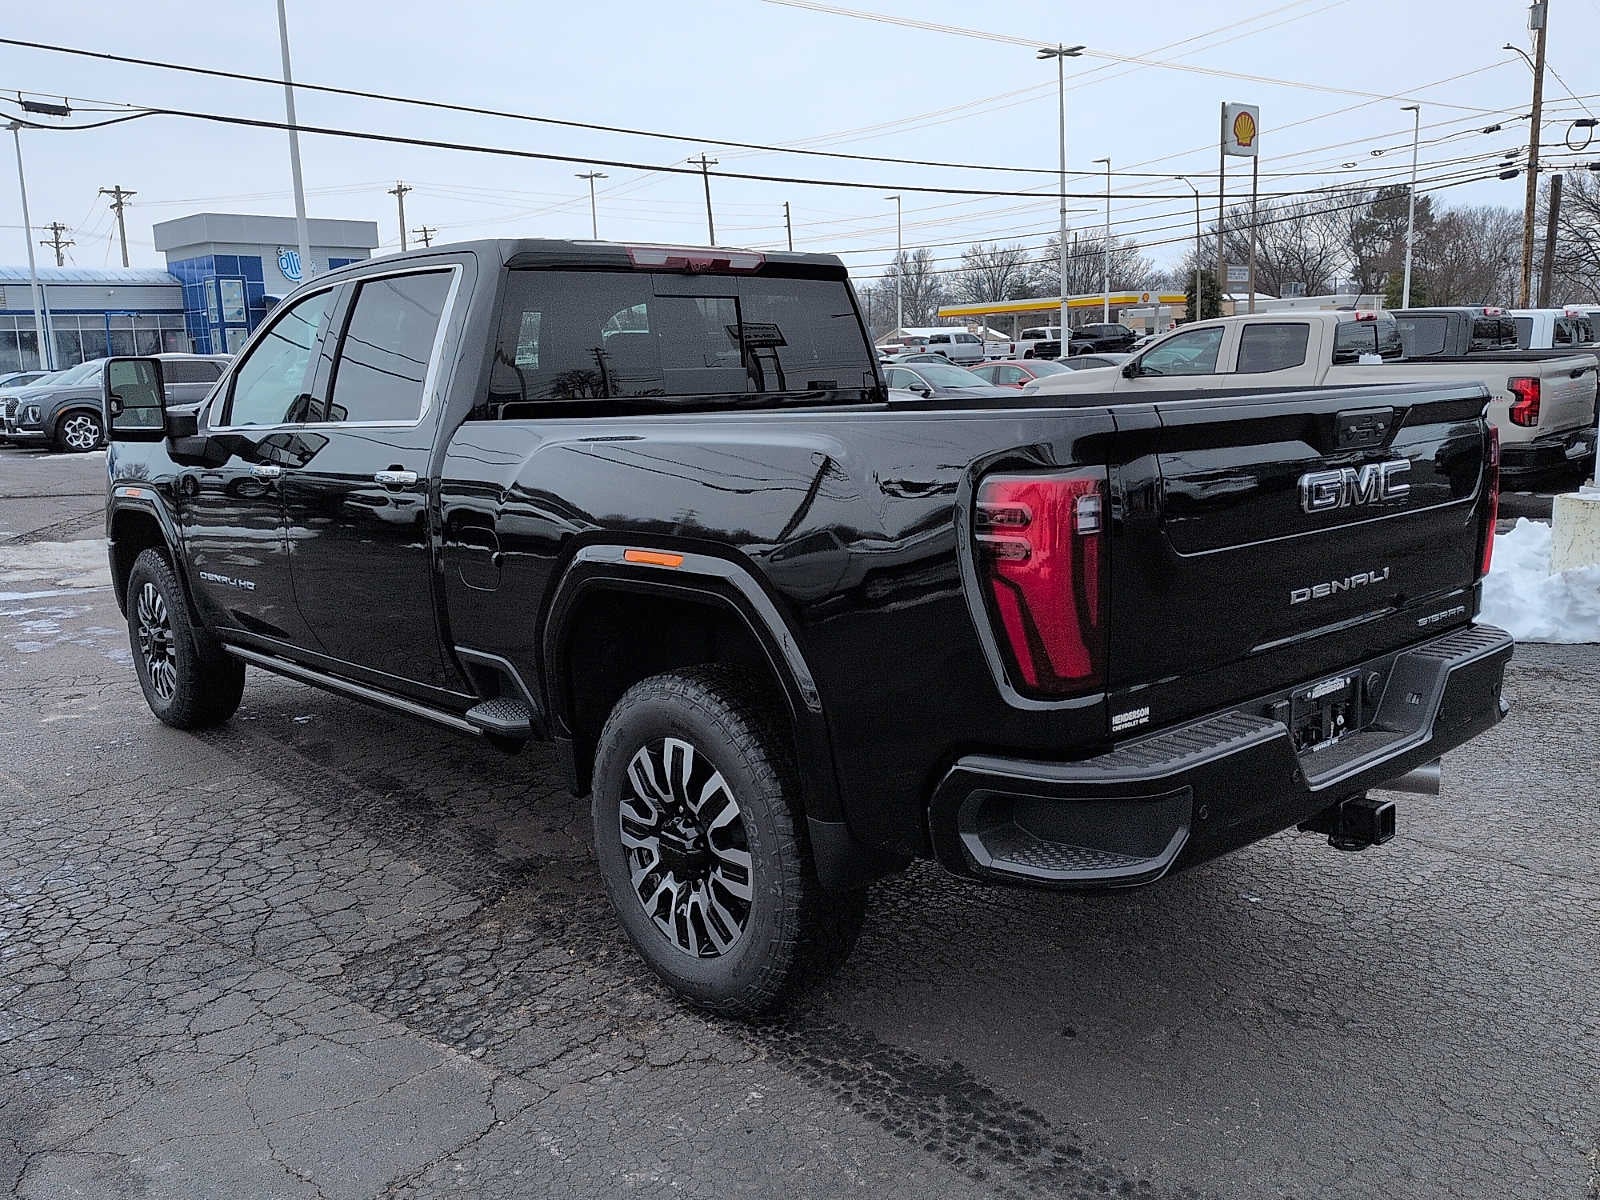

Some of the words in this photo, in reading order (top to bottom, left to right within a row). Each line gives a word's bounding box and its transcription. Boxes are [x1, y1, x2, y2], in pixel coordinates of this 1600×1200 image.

[1298, 459, 1411, 514] GMC
[199, 571, 238, 587] DENALI
[238, 579, 256, 590] HD
[1290, 566, 1390, 605] DENALI
[1417, 605, 1466, 627] SIERRA
[1112, 706, 1150, 726] HENDERSON
